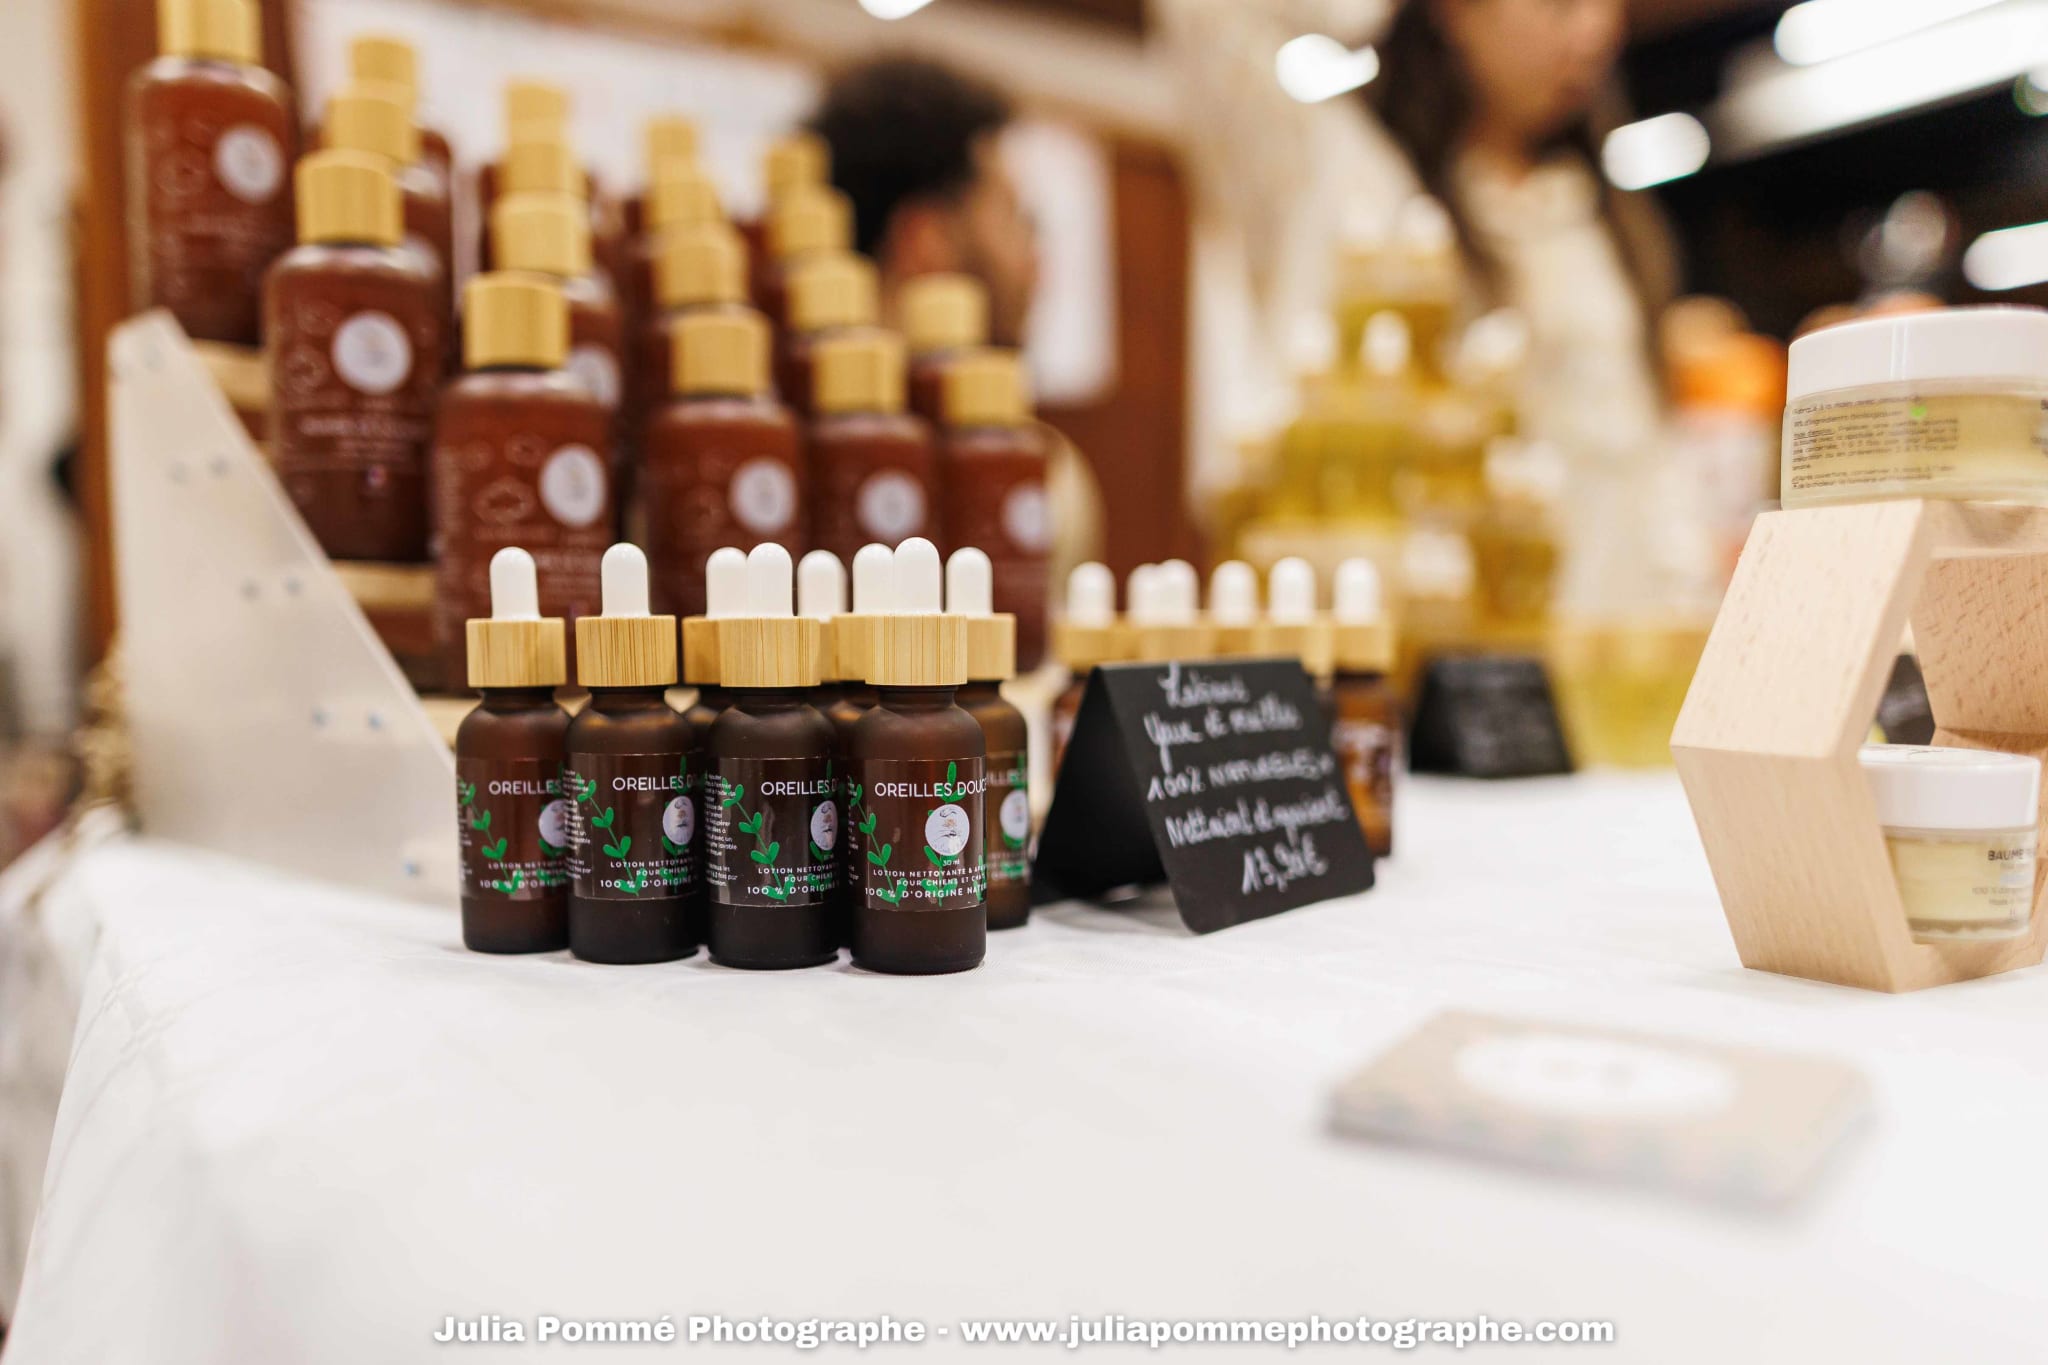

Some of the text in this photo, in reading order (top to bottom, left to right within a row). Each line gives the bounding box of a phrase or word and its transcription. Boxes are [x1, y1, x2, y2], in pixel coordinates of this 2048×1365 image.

[612, 775, 684, 791] OREILLES
[761, 779, 830, 796] OREILLES
[874, 782, 953, 798] OREILLES
[1987, 849, 2024, 861] BAUME
[610, 861, 645, 869] LOTION
[636, 869, 661, 877] POUR
[758, 867, 793, 875] LOTION
[873, 868, 906, 878] LOTION
[909, 868, 966, 878] NETTOYANTE
[600, 880, 622, 889] 100
[626, 880, 636, 889] %
[784, 875, 808, 883] POUR
[896, 878, 922, 888] POUR
[926, 879, 957, 888] CHIENS
[961, 876, 969, 884] ET
[747, 885, 769, 896] 100
[774, 885, 784, 896] %
[865, 887, 882, 897] 100
[887, 889, 896, 898] %
[902, 887, 963, 899] D'ORIGINE
